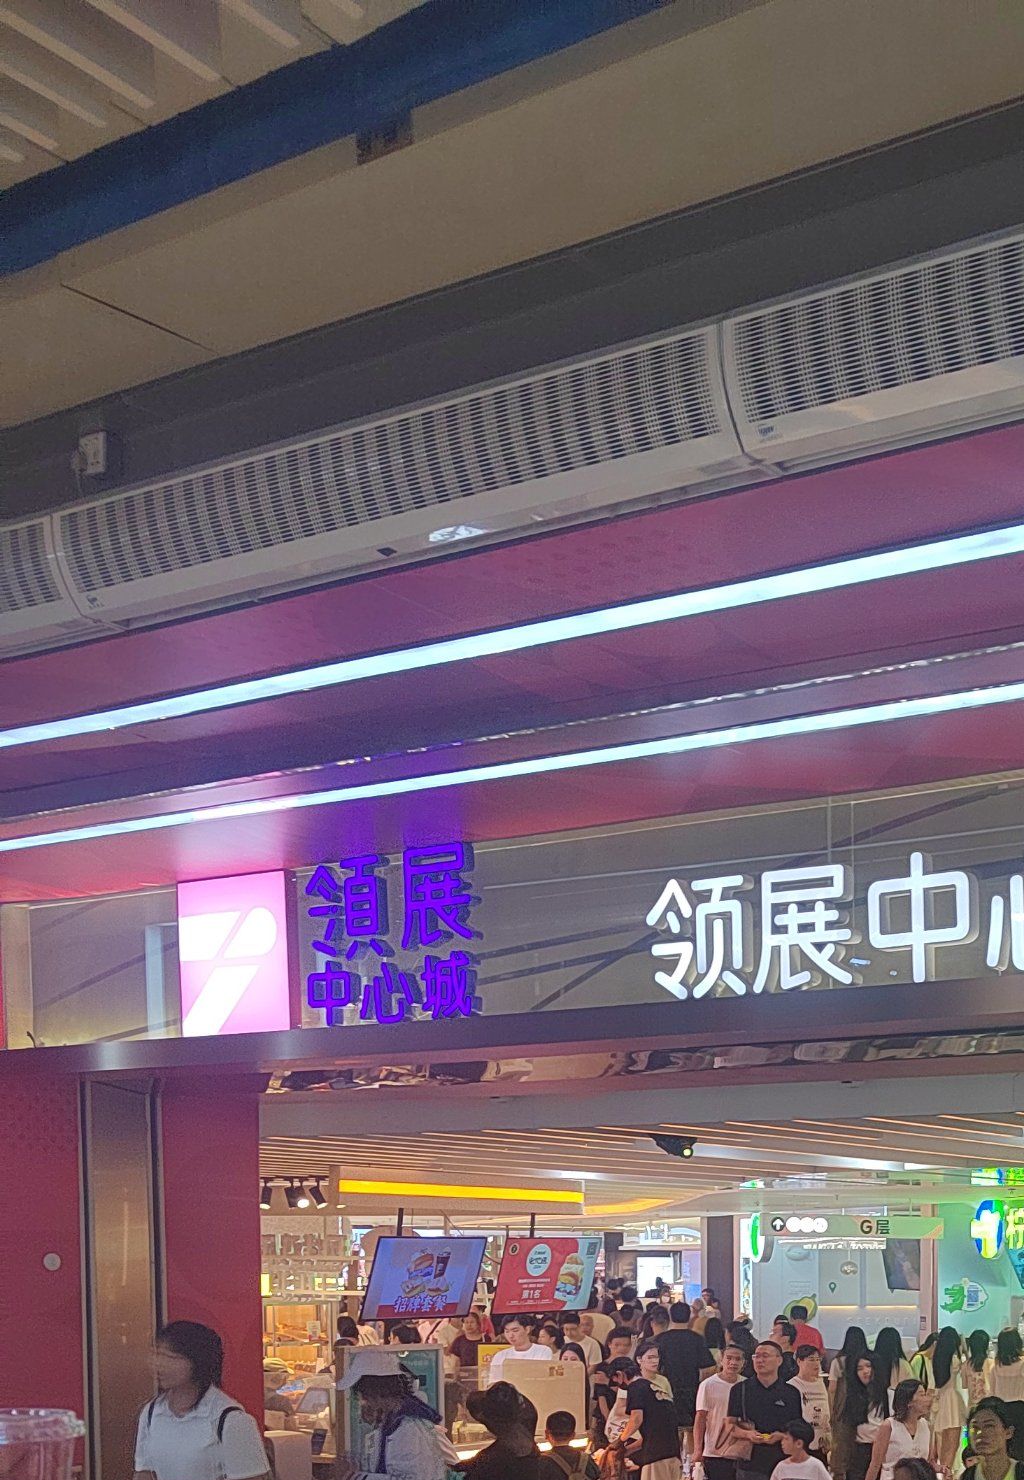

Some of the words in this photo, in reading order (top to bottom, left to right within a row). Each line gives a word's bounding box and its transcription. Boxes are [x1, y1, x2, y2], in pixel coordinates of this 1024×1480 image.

[306, 841, 476, 961] 領展
[307, 951, 473, 1027] 中心城
[860, 1219, 891, 1235] G层
[394, 1295, 447, 1313] 招牌套餐
